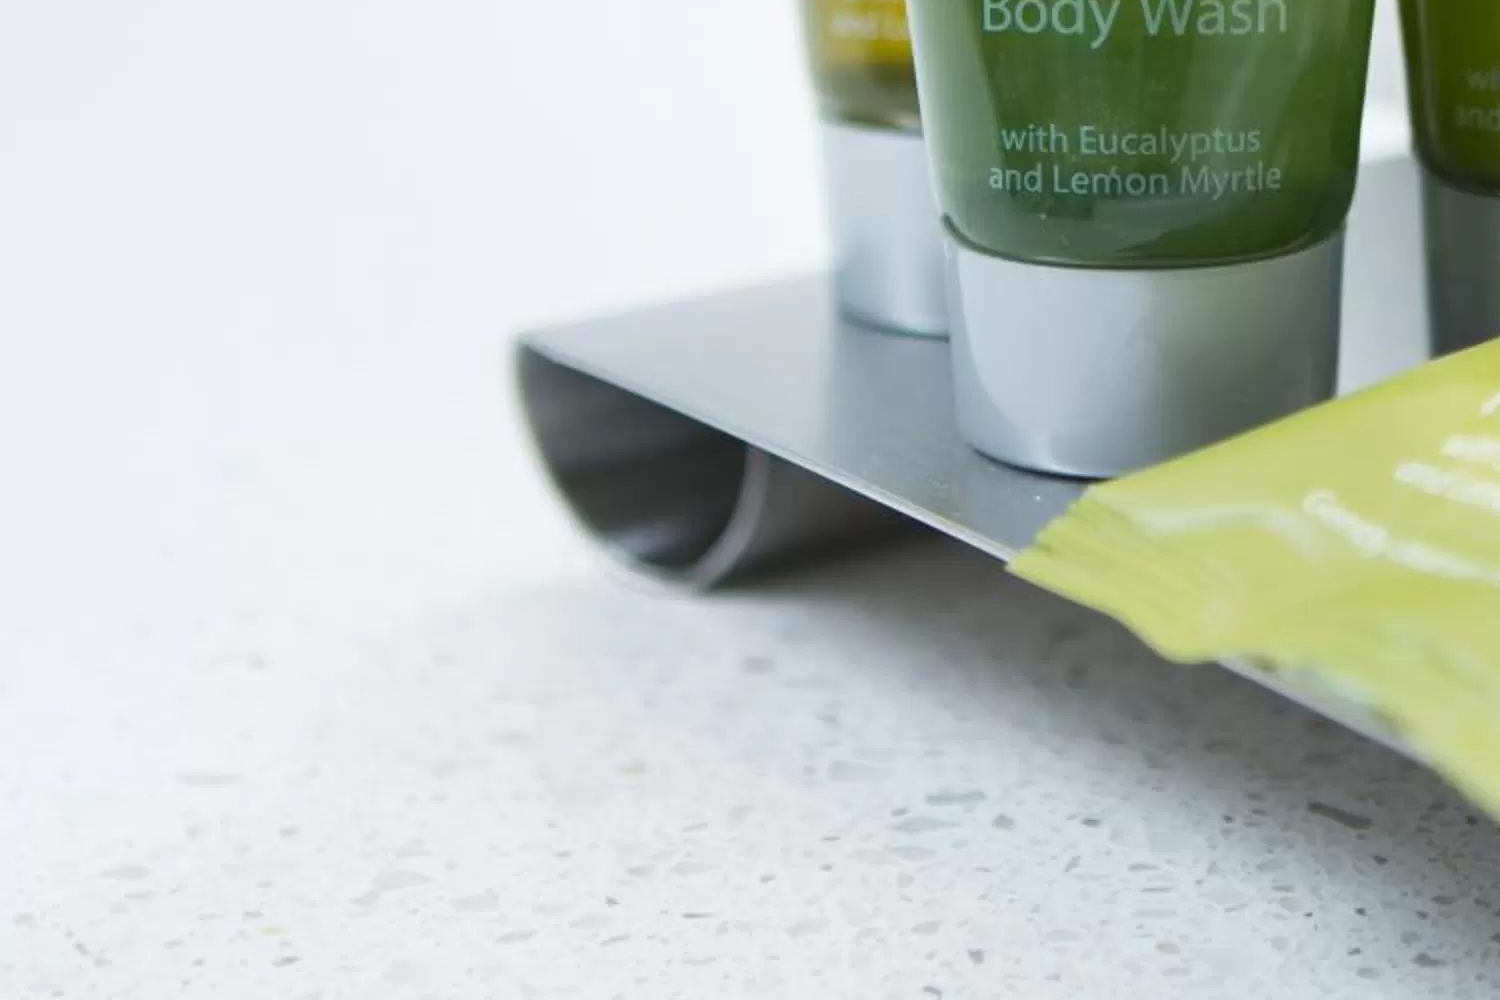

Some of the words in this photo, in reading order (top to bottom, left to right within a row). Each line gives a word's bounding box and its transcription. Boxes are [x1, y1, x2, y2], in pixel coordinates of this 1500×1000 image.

[1001, 123, 1068, 153] with
[1080, 124, 1261, 163] Eucalyptus
[988, 163, 1043, 194] and
[1053, 164, 1169, 196] Lemon
[1180, 161, 1282, 200] Myrtle
